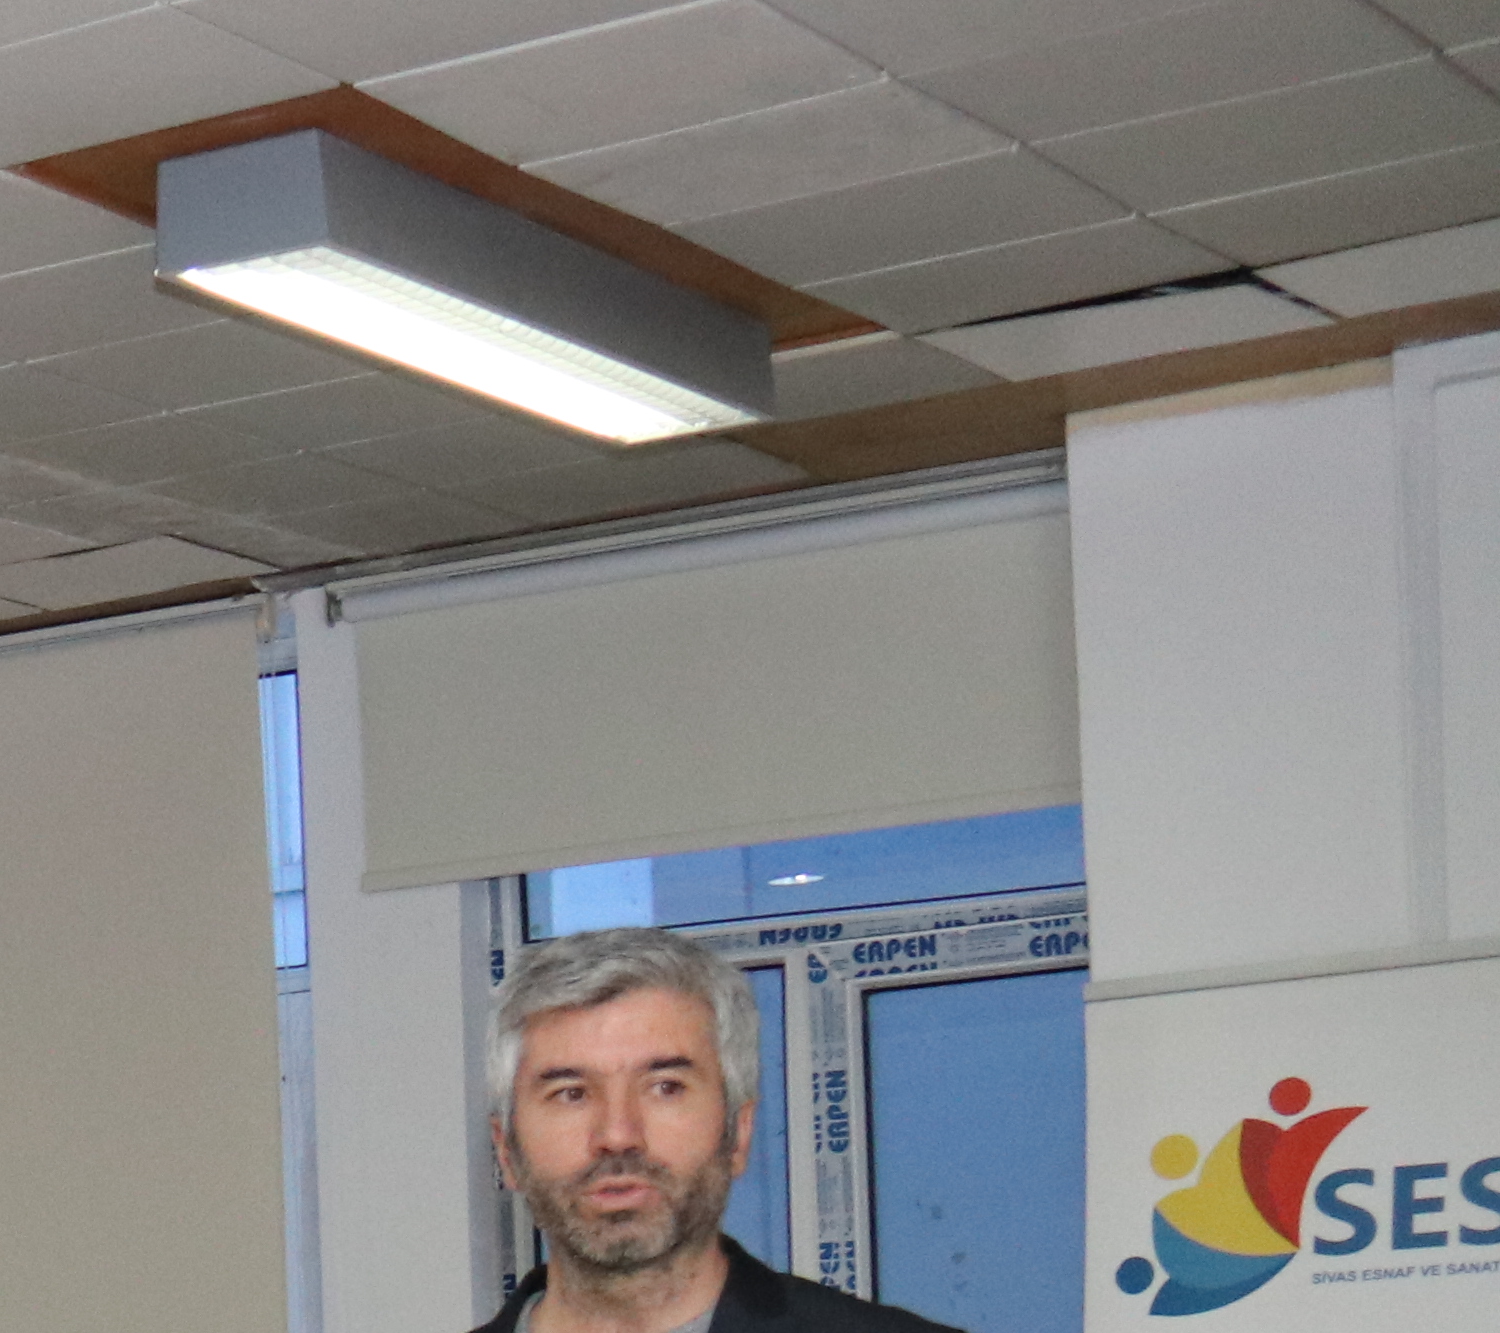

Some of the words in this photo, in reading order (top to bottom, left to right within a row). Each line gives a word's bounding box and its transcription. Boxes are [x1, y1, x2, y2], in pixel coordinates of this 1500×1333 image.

[852, 933, 937, 964] ERPEN
[1029, 931, 1088, 957] ERP
[824, 1069, 851, 1153] ERPEN
[1362, 1265, 1416, 1282] ESNAF
[1421, 1263, 1442, 1277] VE
